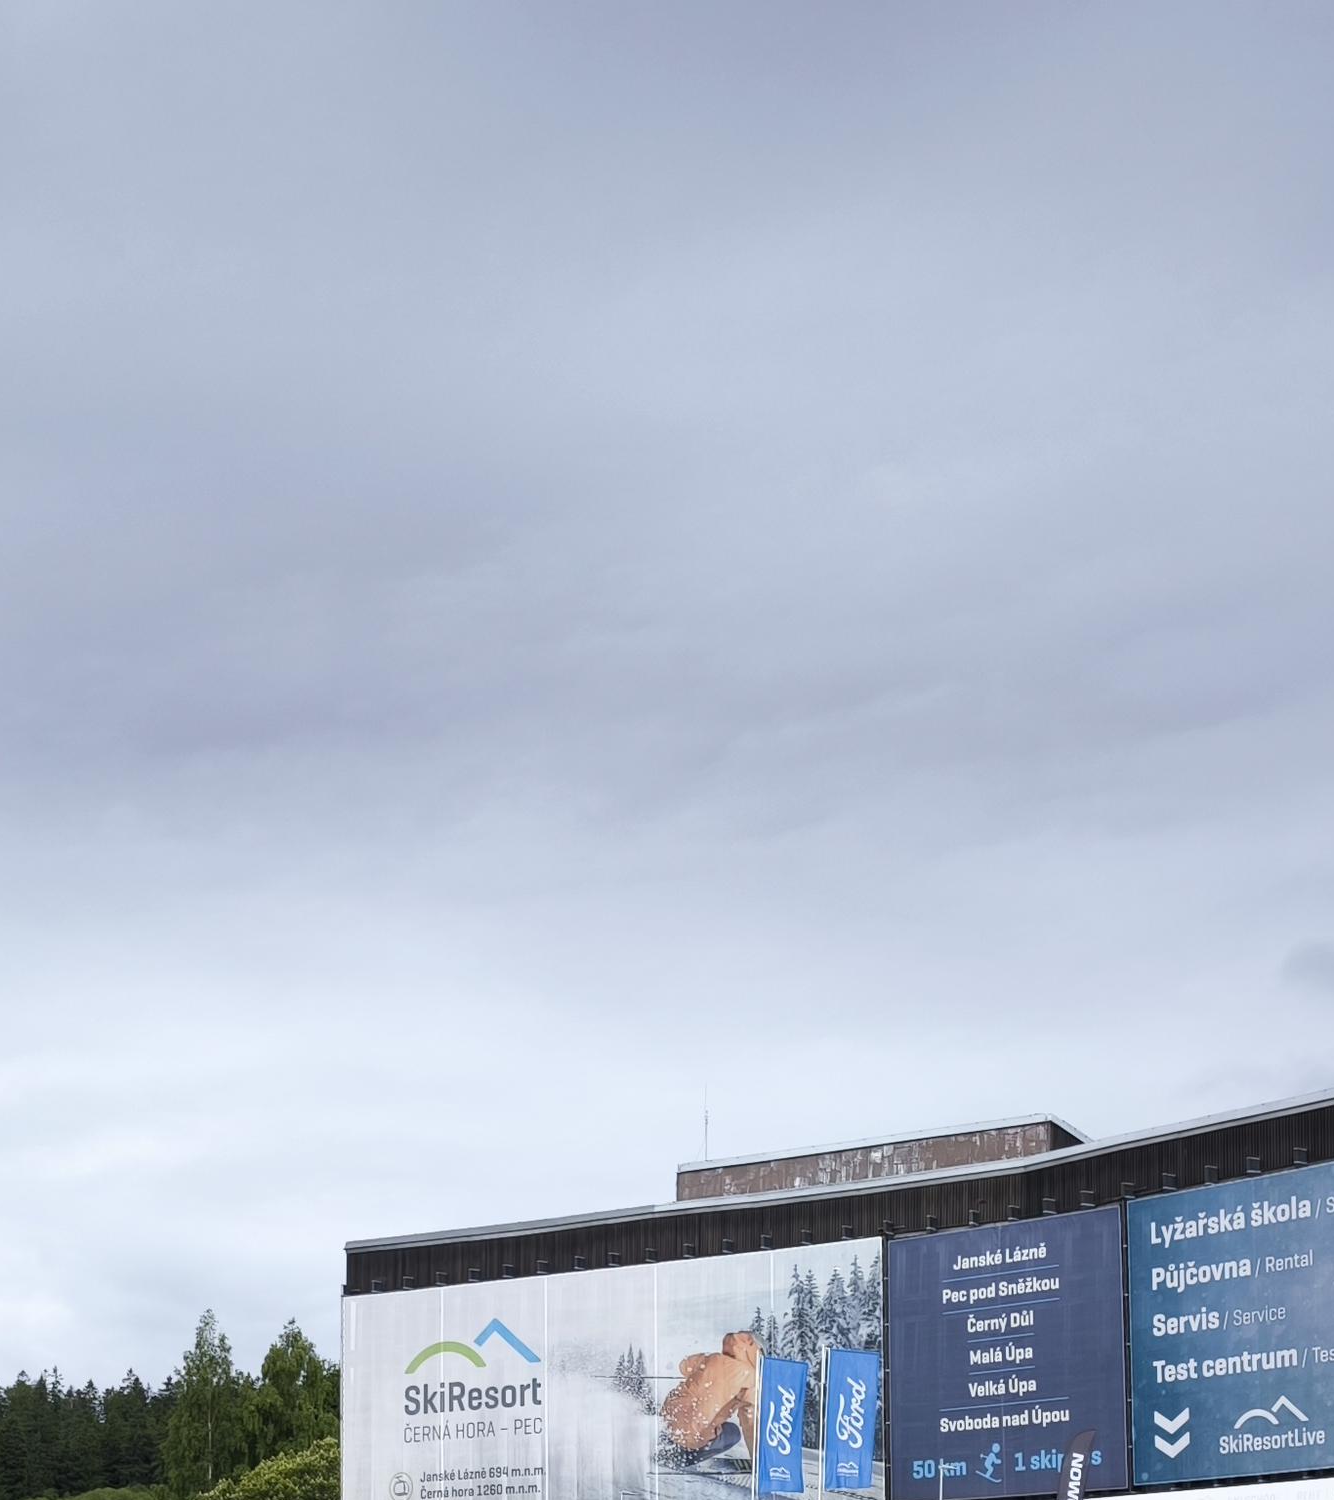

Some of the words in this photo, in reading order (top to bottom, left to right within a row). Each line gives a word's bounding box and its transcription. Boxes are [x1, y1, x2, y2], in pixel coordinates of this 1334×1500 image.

[1150, 1205, 1246, 1248] Lyžařská
[1250, 1195, 1312, 1228] škola
[953, 1249, 1002, 1271] Janské
[1005, 1242, 1047, 1264] Lázně
[1151, 1257, 1252, 1293] Půjčovna
[1265, 1249, 1314, 1273] Rental
[942, 1289, 967, 1304] Pec
[969, 1282, 996, 1304] pod
[998, 1276, 1060, 1297] Sněžkou
[967, 1313, 1007, 1333] Černý
[1010, 1310, 1034, 1328] Důl
[1152, 1306, 1220, 1337] Servis
[1233, 1305, 1286, 1327] Service
[969, 1347, 1003, 1365] Malá
[1005, 1342, 1033, 1364] Úpa
[1152, 1358, 1198, 1384] Test
[1202, 1347, 1299, 1378] centrum
[404, 1377, 542, 1416] SkiResort
[968, 1378, 1006, 1398] Velká
[1008, 1374, 1037, 1397] Úpa
[766, 1385, 796, 1456] Ford
[836, 1376, 867, 1449] Ford
[939, 1411, 1000, 1433] Svoboda
[1002, 1408, 1029, 1428] nad
[1031, 1405, 1070, 1427] Úpou
[403, 1419, 451, 1444] ČERNÁ
[456, 1420, 496, 1439] HORA
[514, 1417, 543, 1436] PEC
[1219, 1427, 1326, 1455] SkiResortLive
[420, 1468, 456, 1483] Janské
[457, 1465, 487, 1480] Lázně
[489, 1466, 509, 1479] 694
[912, 1459, 936, 1480] 50
[1014, 1452, 1026, 1472] 1
[1030, 1449, 1102, 1473] skips
[420, 1486, 449, 1500] Černá
[451, 1484, 475, 1498] hora
[476, 1484, 503, 1496] 1260
